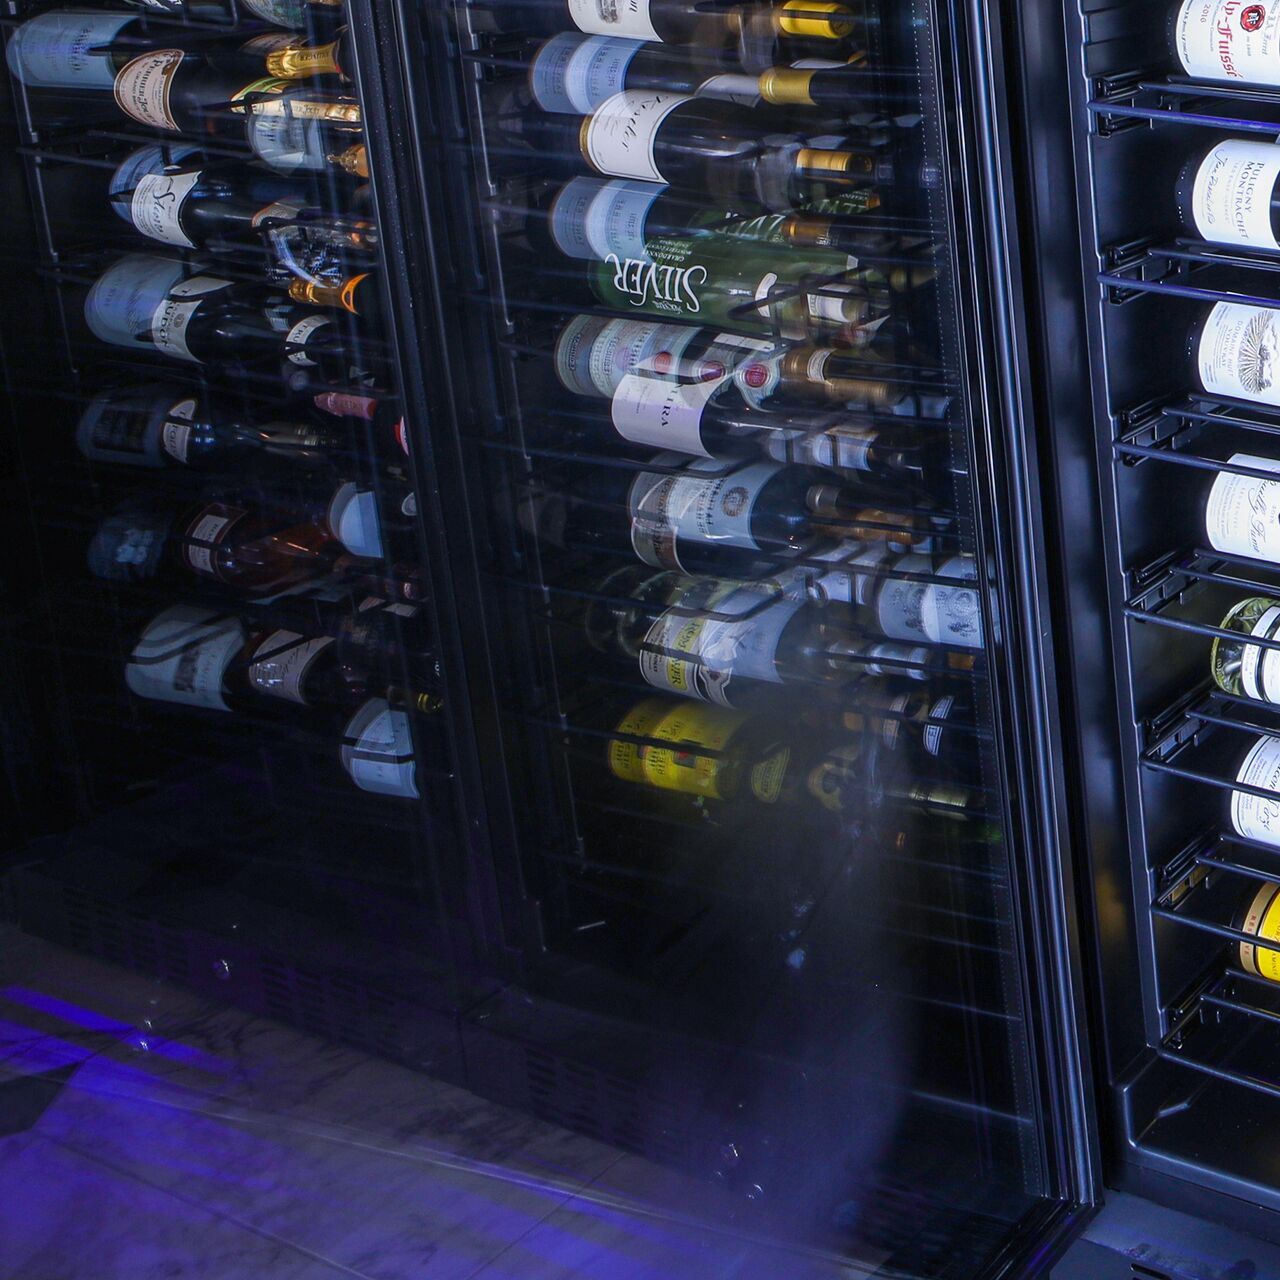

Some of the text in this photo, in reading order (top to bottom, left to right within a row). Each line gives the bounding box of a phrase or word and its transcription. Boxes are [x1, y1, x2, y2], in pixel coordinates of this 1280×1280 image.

[1235, 161, 1257, 239] MONTRACHET
[1245, 162, 1266, 213] PULIGNY
[604, 252, 708, 313] SILVER
